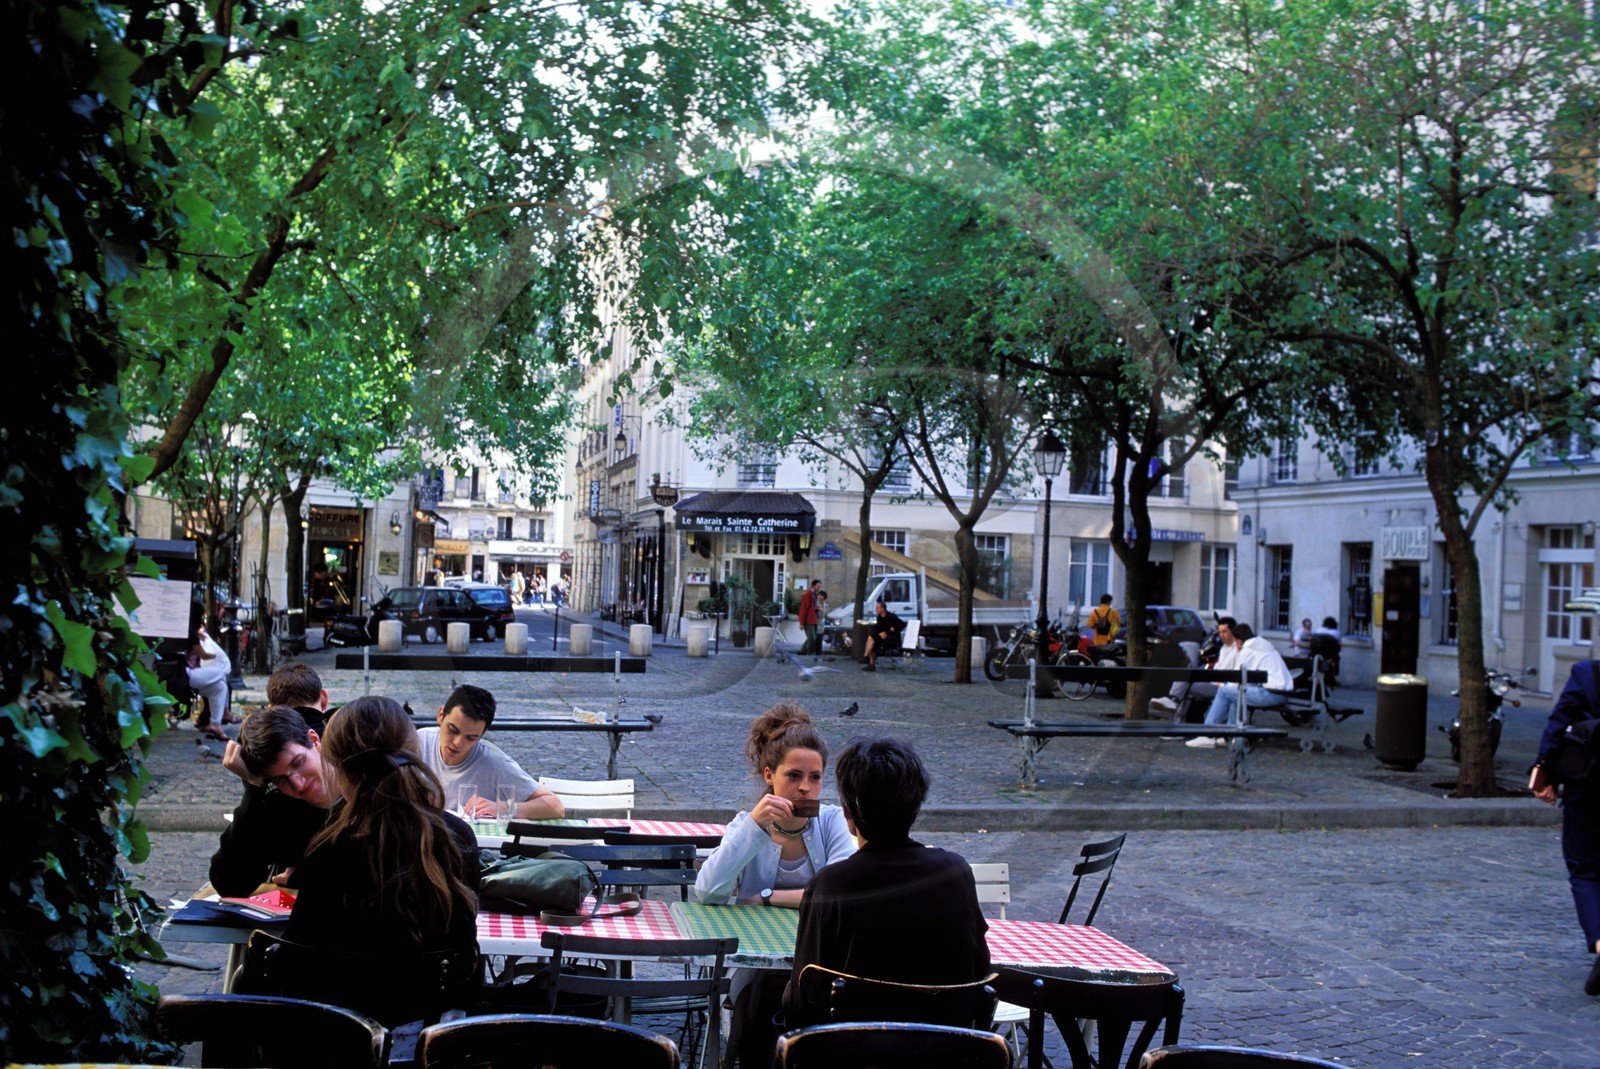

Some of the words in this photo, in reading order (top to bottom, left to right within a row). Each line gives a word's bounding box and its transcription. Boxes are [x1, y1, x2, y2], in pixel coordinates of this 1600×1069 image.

[309, 512, 360, 523] COIFFURE
[682, 516, 691, 525] Le
[696, 517, 722, 526] Marais
[727, 517, 753, 526] Sainte
[757, 518, 799, 528] Catherine
